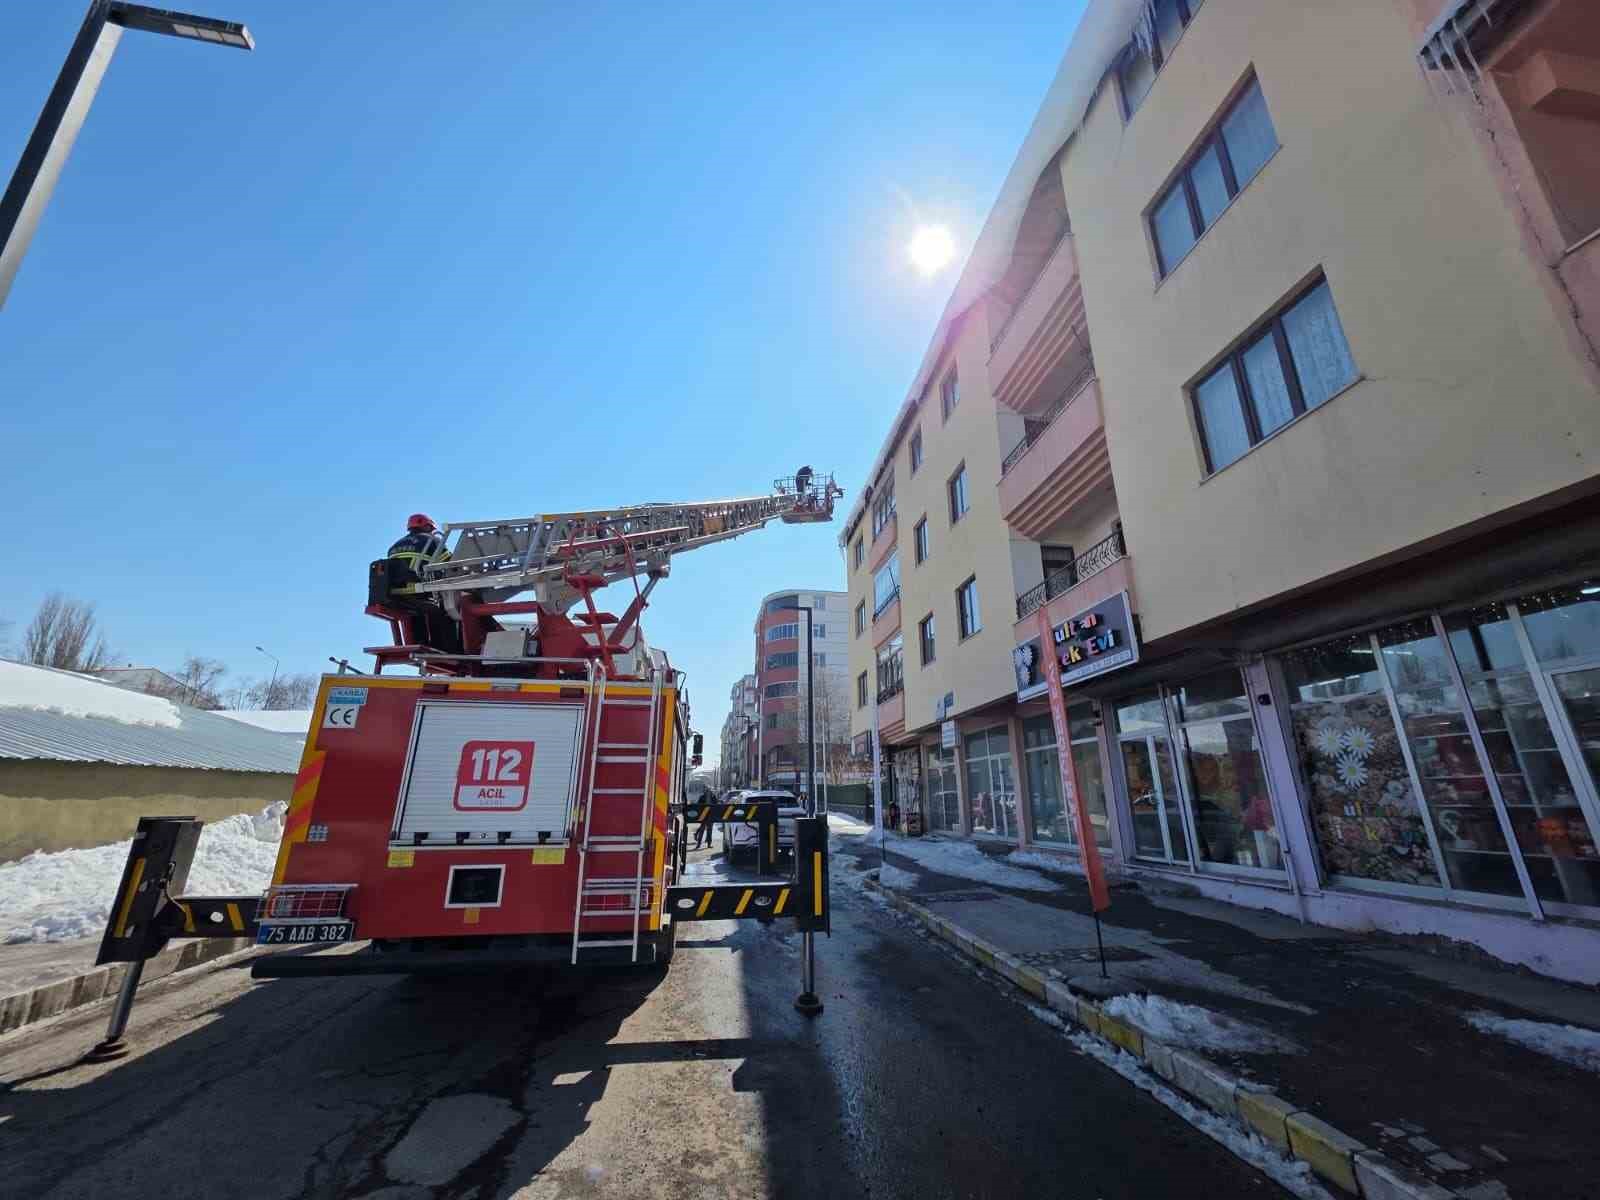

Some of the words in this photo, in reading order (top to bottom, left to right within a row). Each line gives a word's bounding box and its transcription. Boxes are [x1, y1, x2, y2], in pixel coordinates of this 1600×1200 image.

[1054, 613, 1097, 643] ultan
[1086, 628, 1115, 655] Evi
[330, 708, 354, 725] CE
[472, 748, 522, 781] 112
[266, 927, 286, 942] 75
[289, 926, 315, 941] AAB
[319, 925, 346, 941] 382
